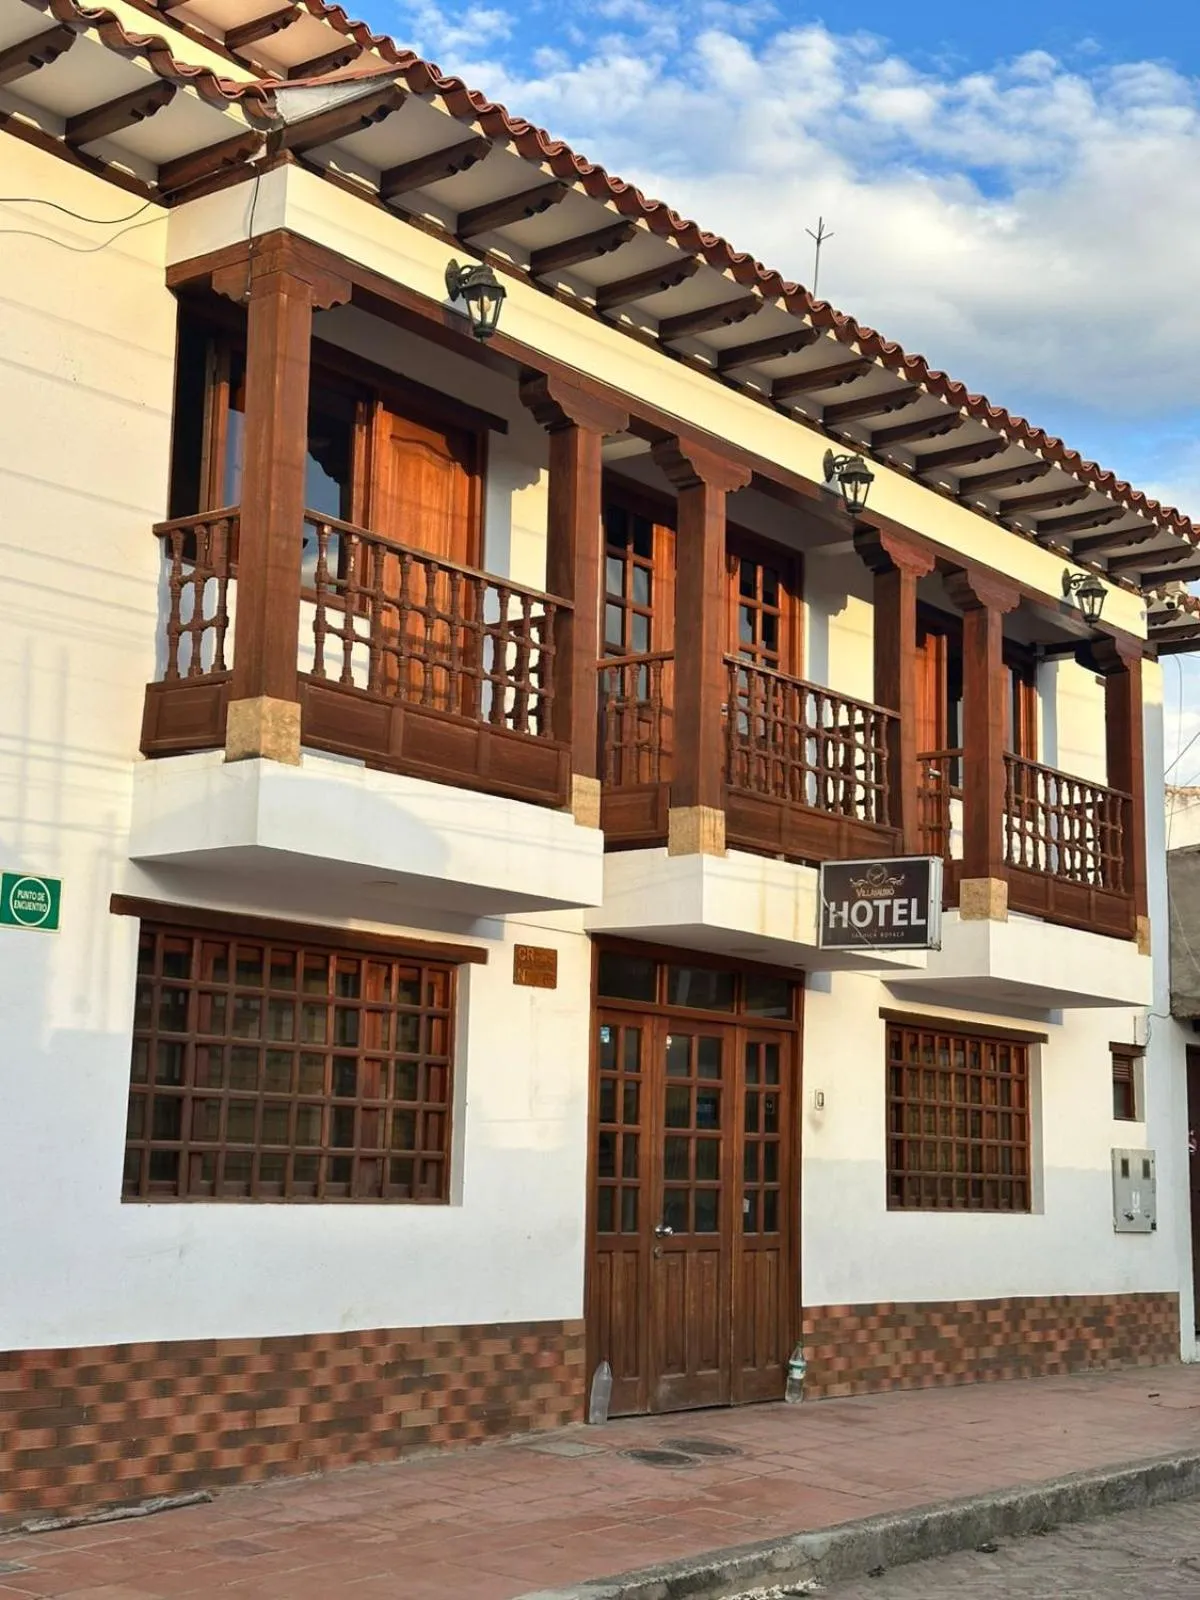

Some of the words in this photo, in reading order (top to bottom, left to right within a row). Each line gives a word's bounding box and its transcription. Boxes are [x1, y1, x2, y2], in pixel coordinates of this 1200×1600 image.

[17, 889, 37, 900] PUNTO
[37, 892, 46, 902] DE
[829, 898, 926, 928] HOTEL
